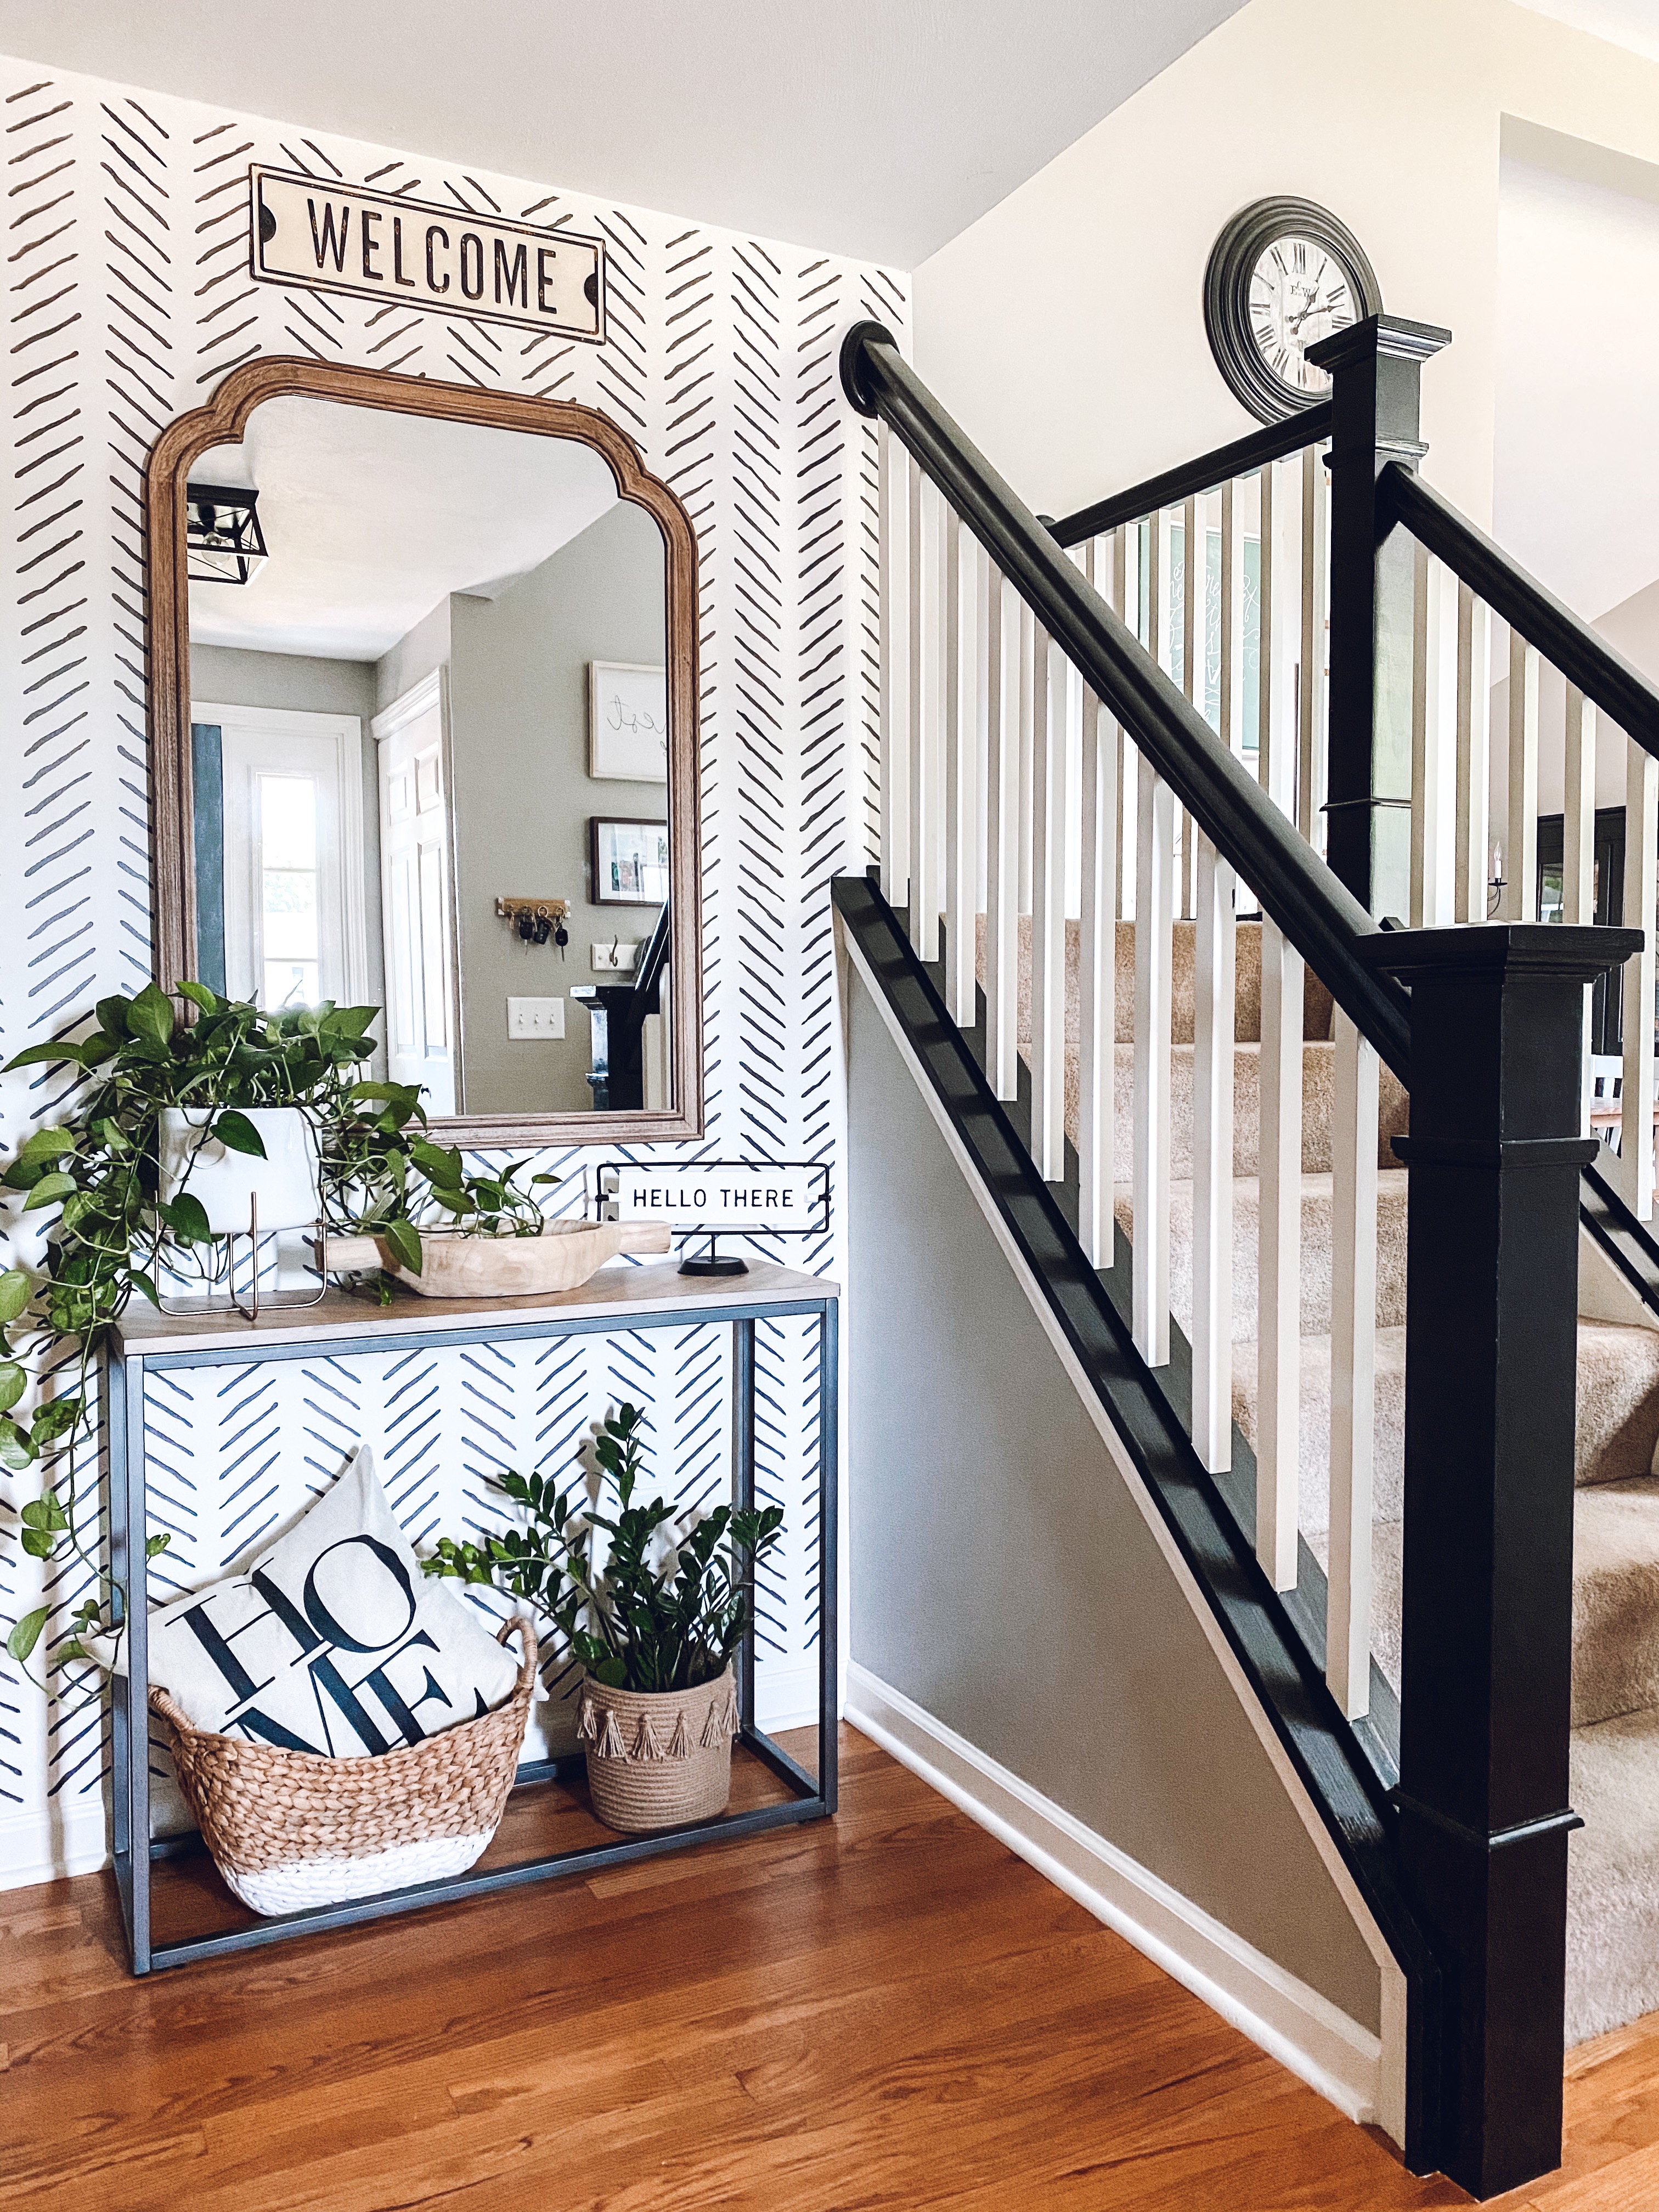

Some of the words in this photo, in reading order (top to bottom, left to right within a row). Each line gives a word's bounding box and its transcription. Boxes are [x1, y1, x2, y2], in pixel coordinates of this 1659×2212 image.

[307, 198, 557, 314] WELCOME
[1292, 242, 1306, 274] XII
[634, 1188, 707, 1207] HELLO
[720, 1188, 793, 1207] THERE
